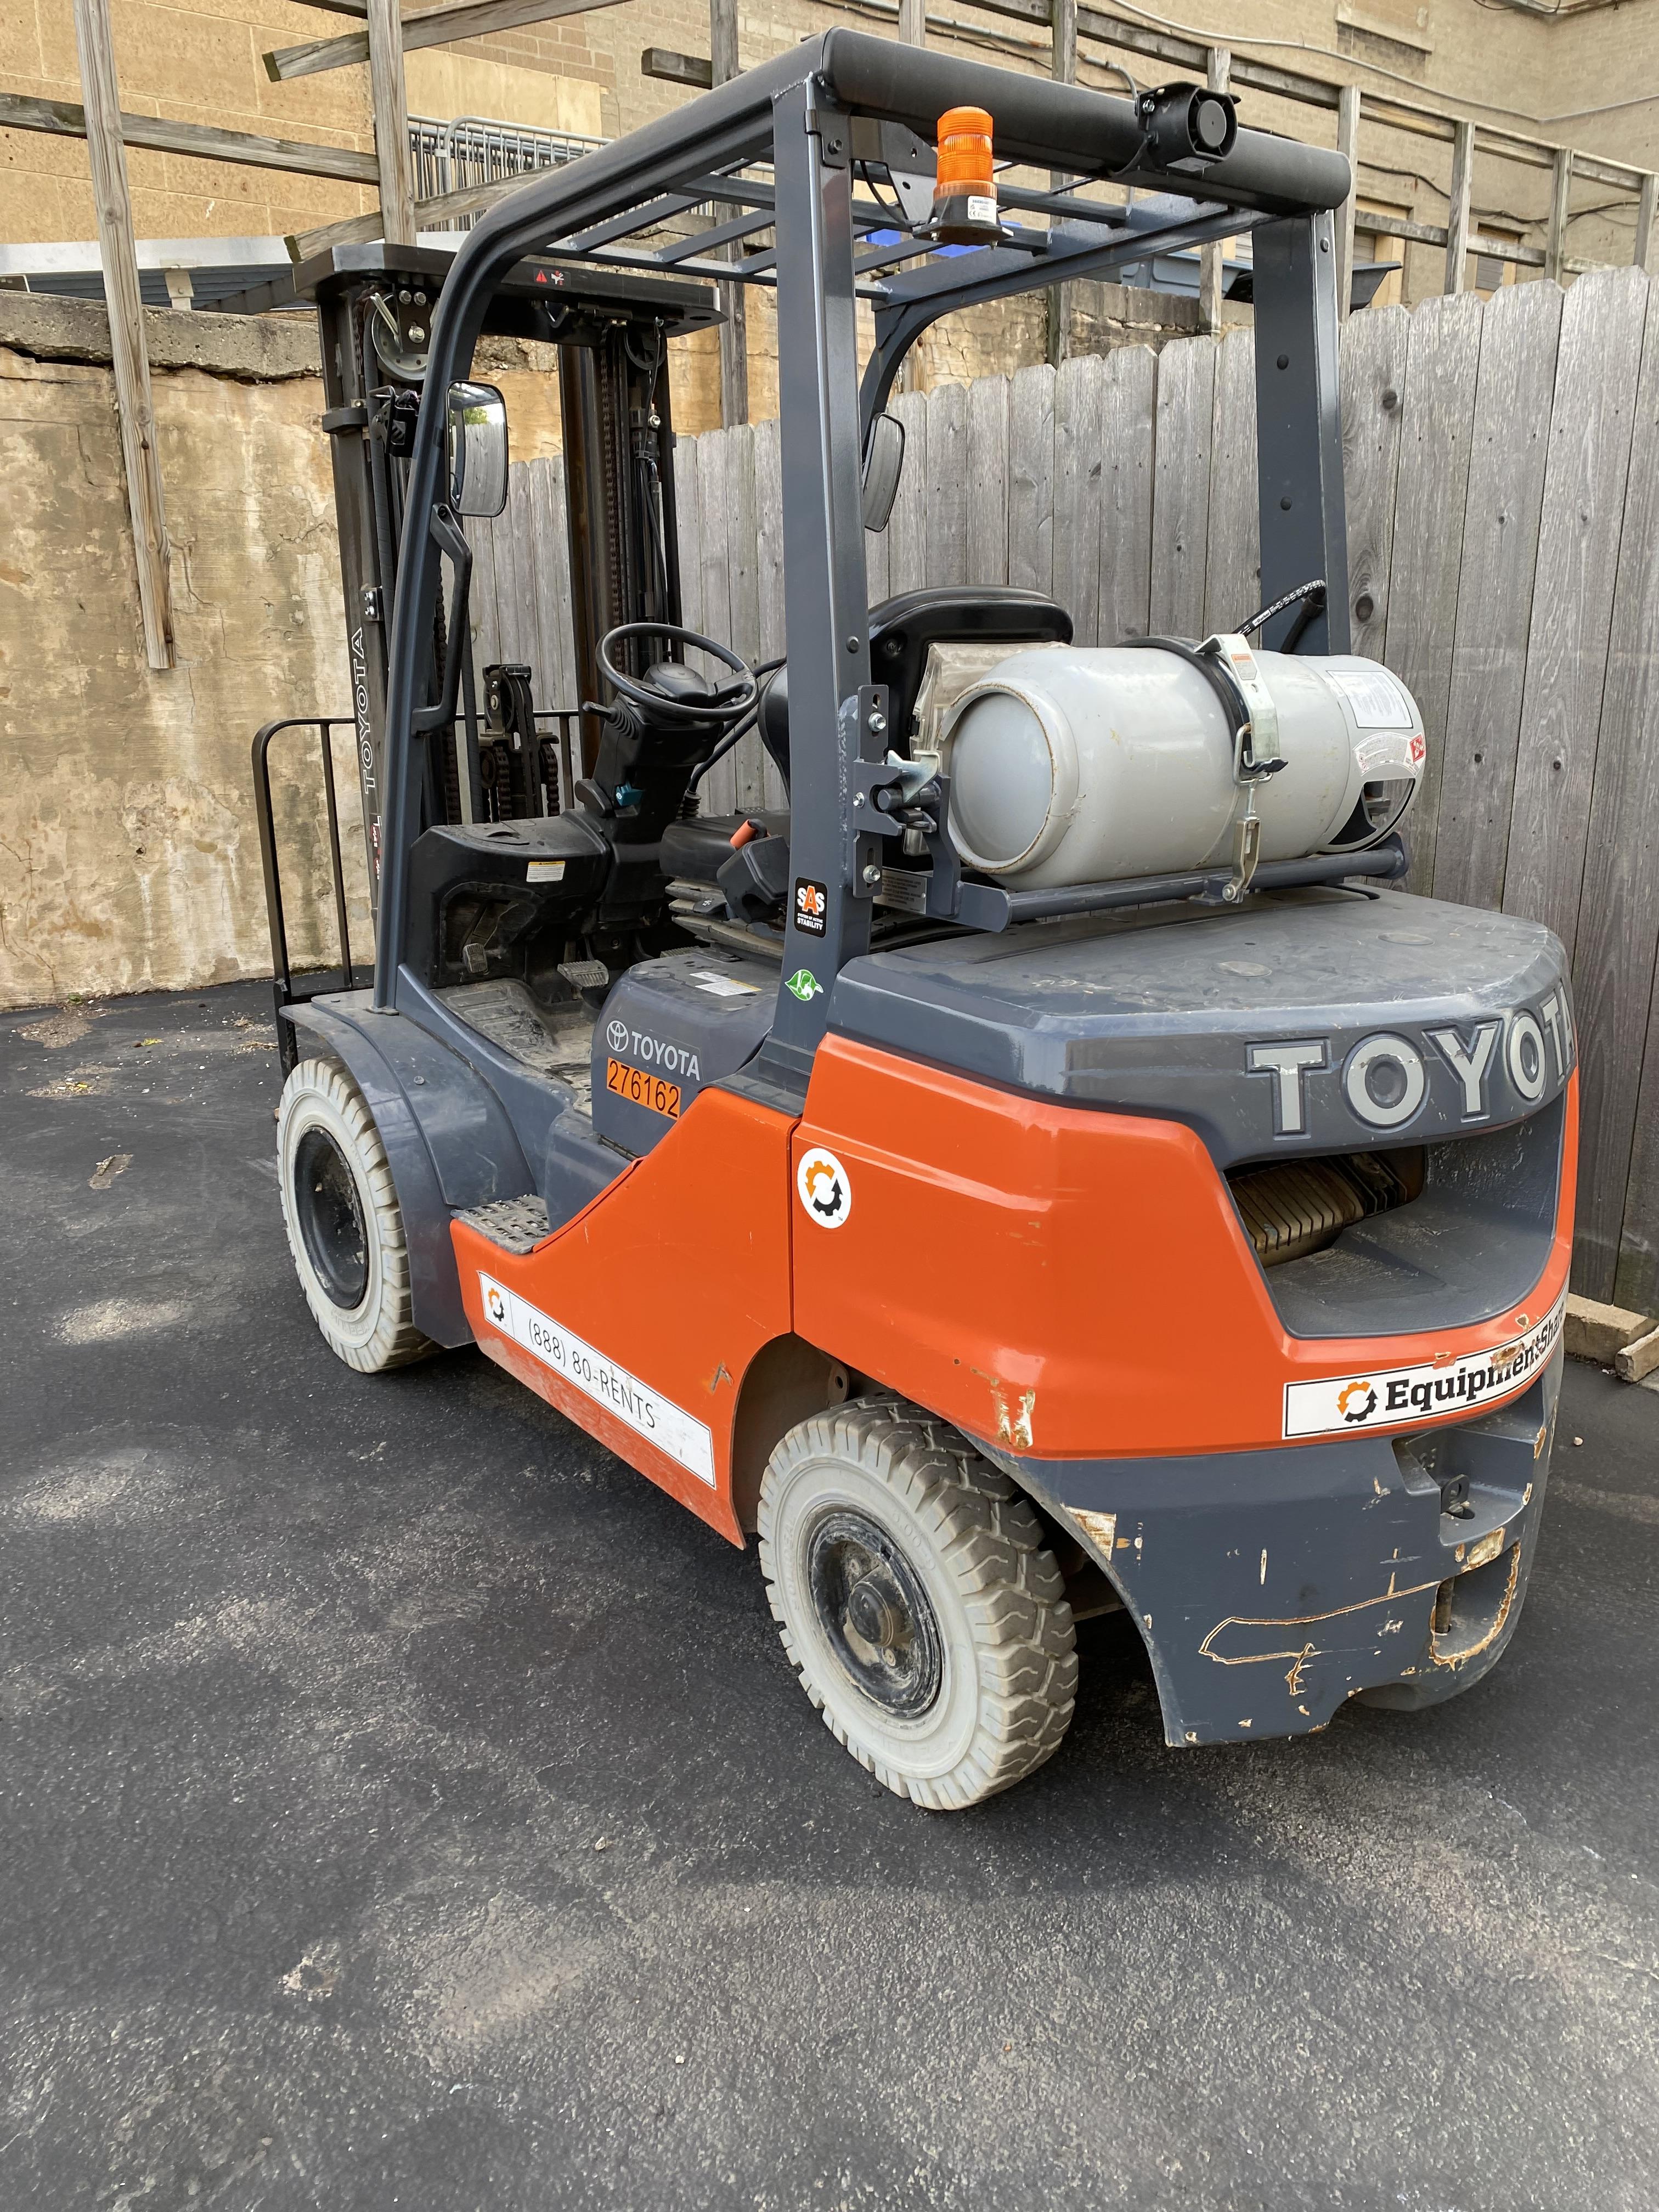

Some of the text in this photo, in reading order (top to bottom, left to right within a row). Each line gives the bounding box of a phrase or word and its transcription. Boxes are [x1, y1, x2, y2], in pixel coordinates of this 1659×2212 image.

[352, 627, 375, 794] TOYOTA
[797, 885, 825, 915] SAS
[797, 917, 823, 930] STABILITY
[631, 1031, 701, 1081] TOYOTA
[1252, 985, 1575, 1131] TOYOTA
[608, 1060, 679, 1118] 276162
[529, 1318, 656, 1429] (888) 80-RENTS
